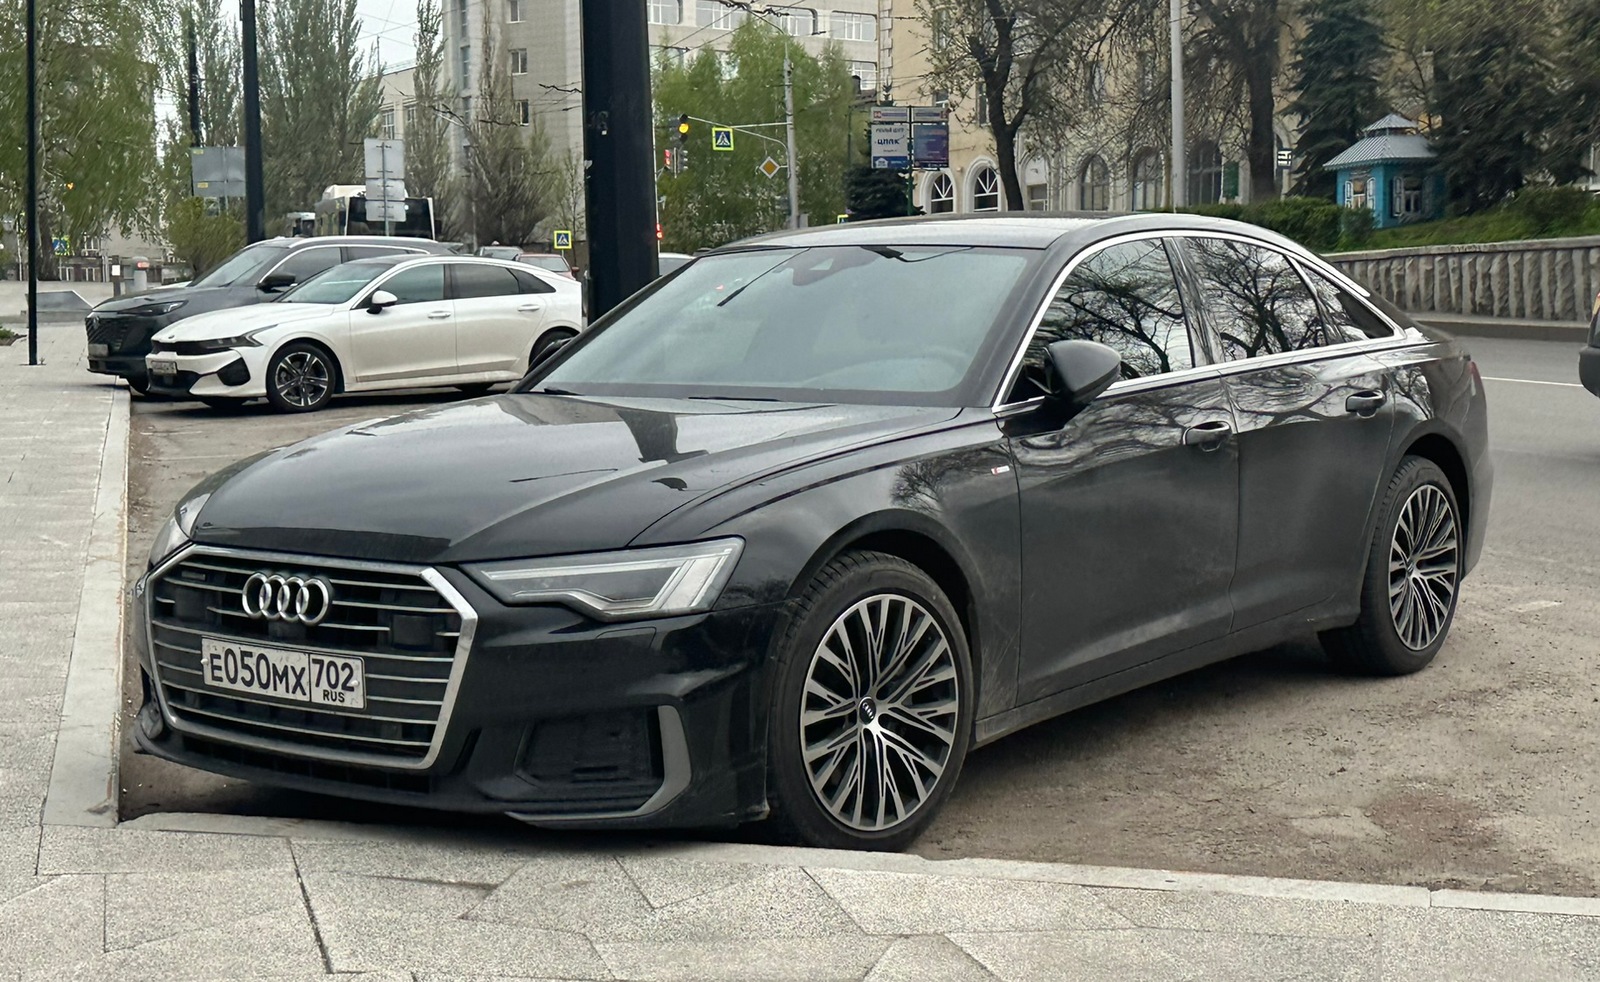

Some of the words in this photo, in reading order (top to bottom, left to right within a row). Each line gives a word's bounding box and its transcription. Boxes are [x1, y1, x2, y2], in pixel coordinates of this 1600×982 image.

[209, 648, 307, 696] Е050МХ
[311, 658, 355, 692] 702
[322, 690, 345, 703] RUS
